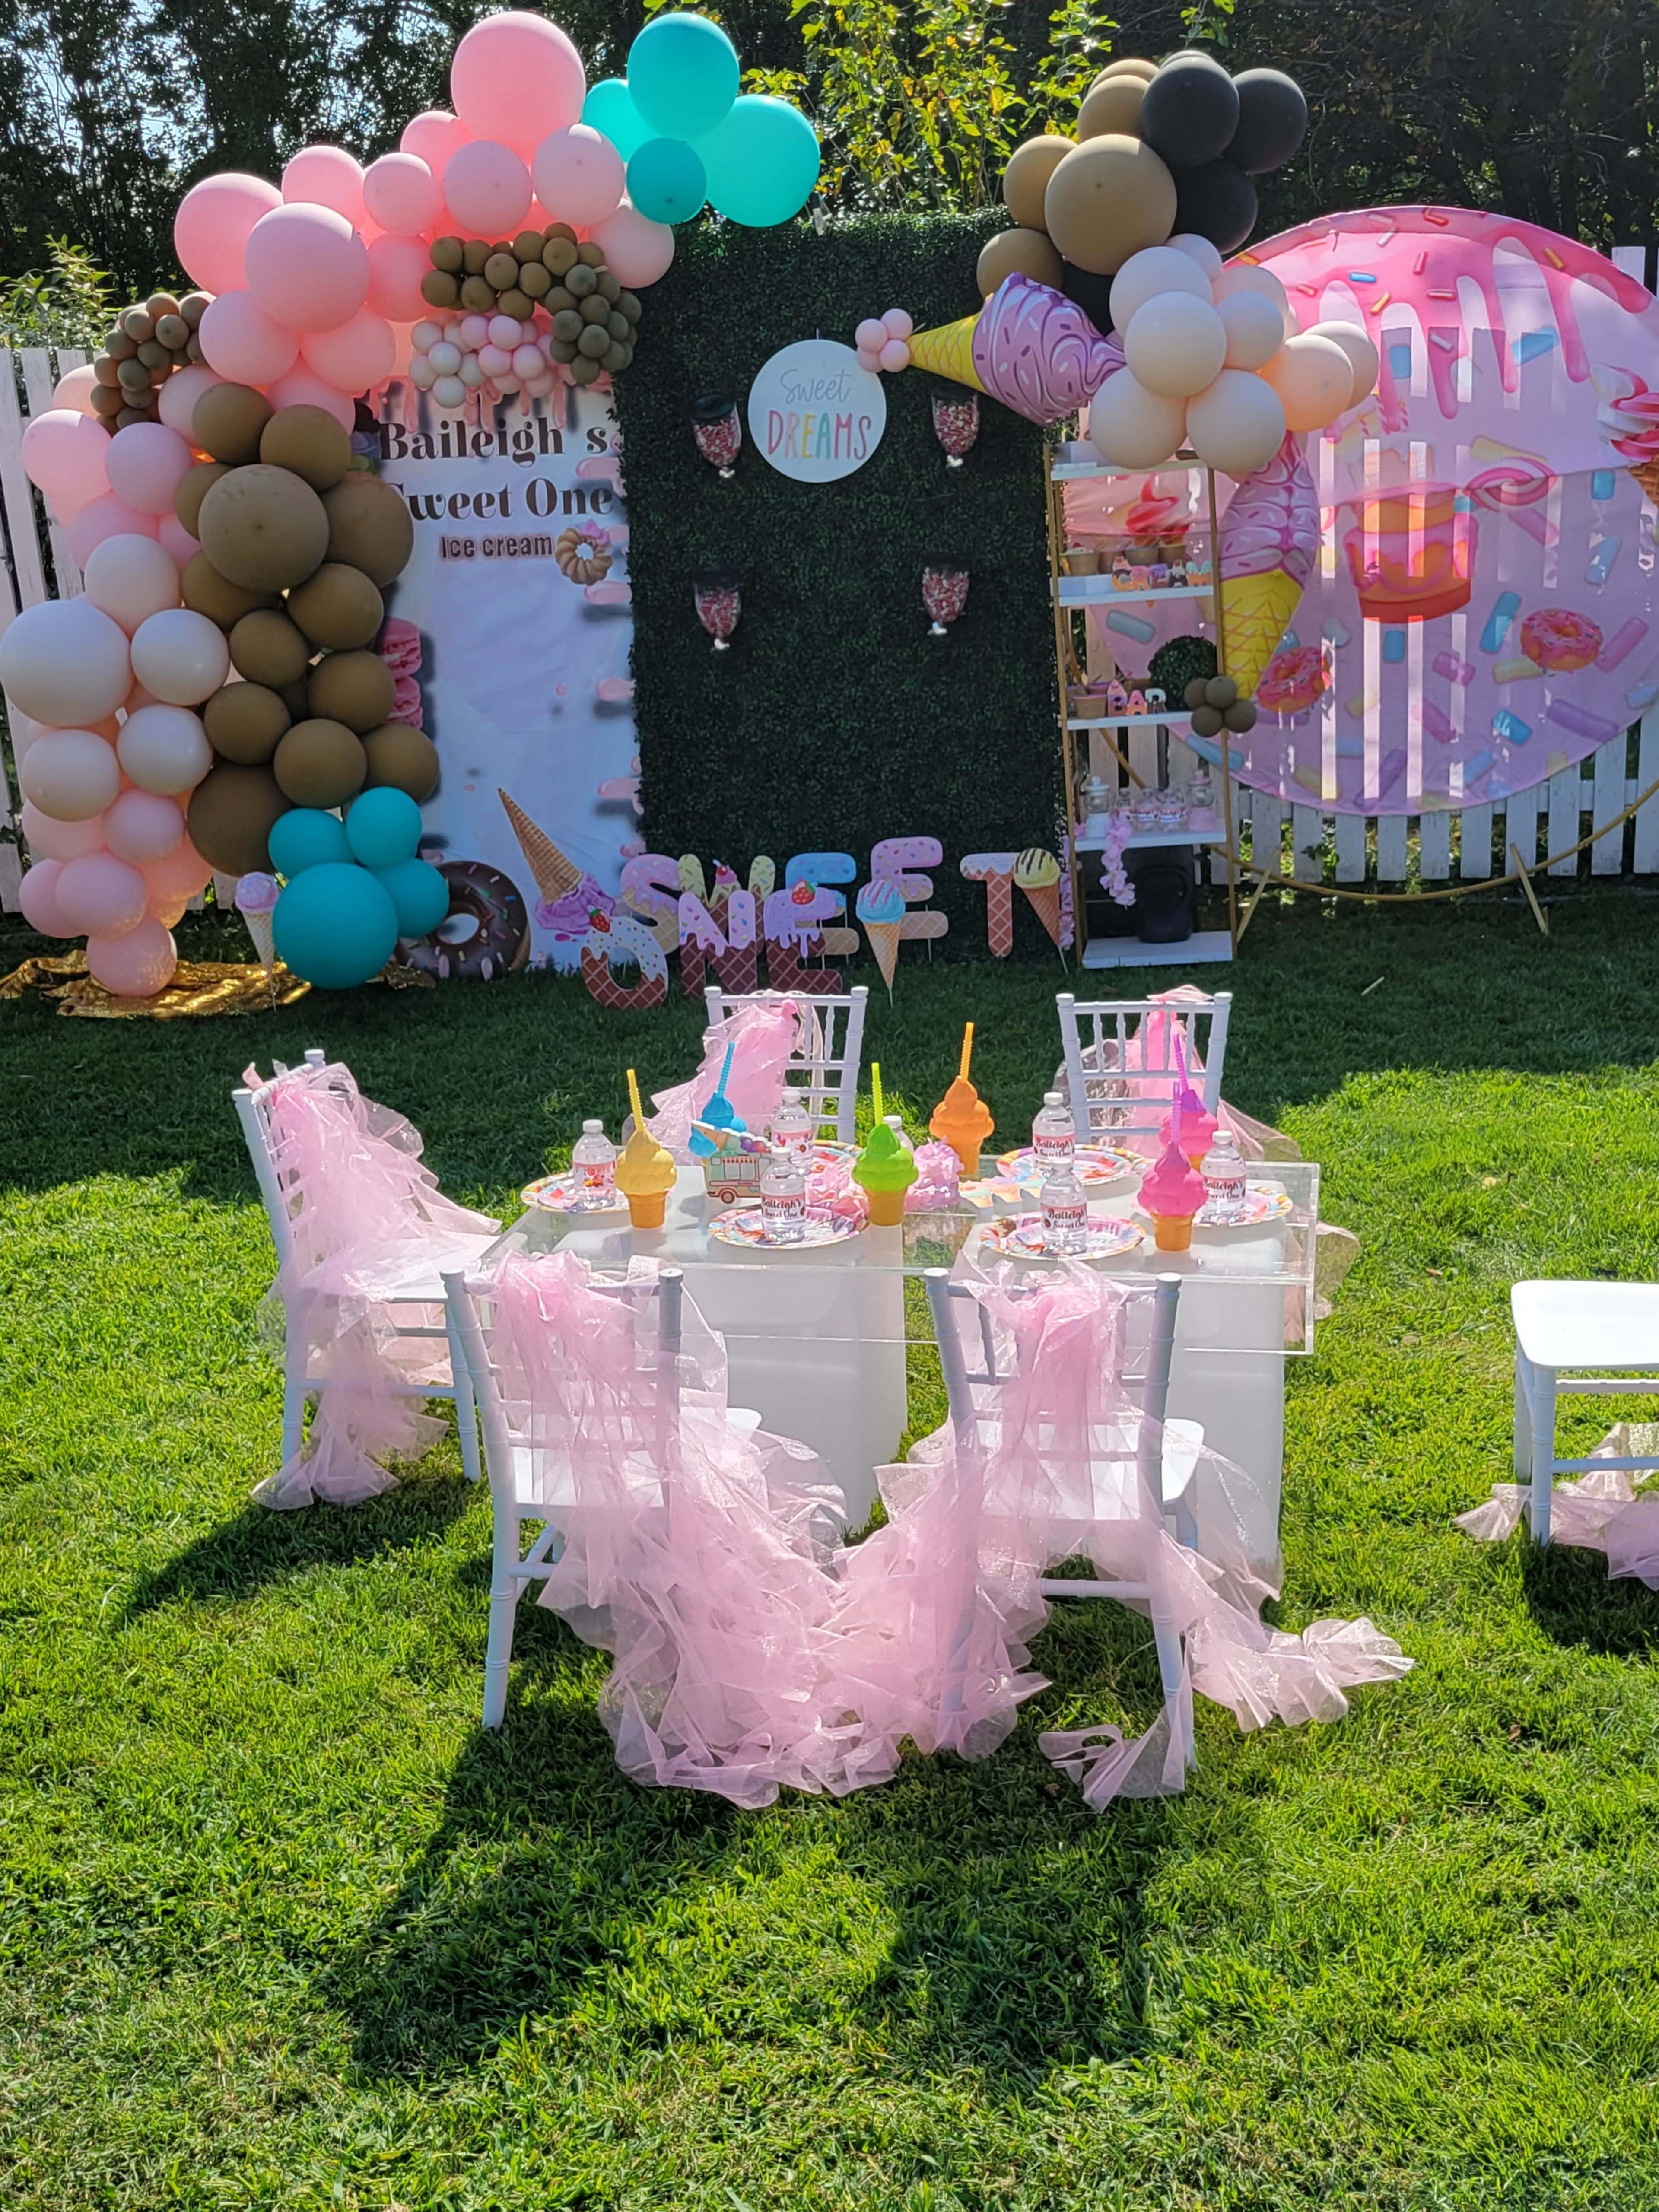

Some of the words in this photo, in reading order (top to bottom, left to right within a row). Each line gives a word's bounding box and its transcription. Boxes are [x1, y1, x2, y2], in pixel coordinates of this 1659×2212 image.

[780, 369, 852, 404] Sweet
[380, 417, 565, 468] Baileigh
[767, 410, 871, 460] DREAMS
[388, 483, 513, 521] weet
[526, 477, 614, 517] One
[442, 537, 475, 558] Ice
[483, 535, 553, 557] cream
[581, 886, 843, 1009] ONE
